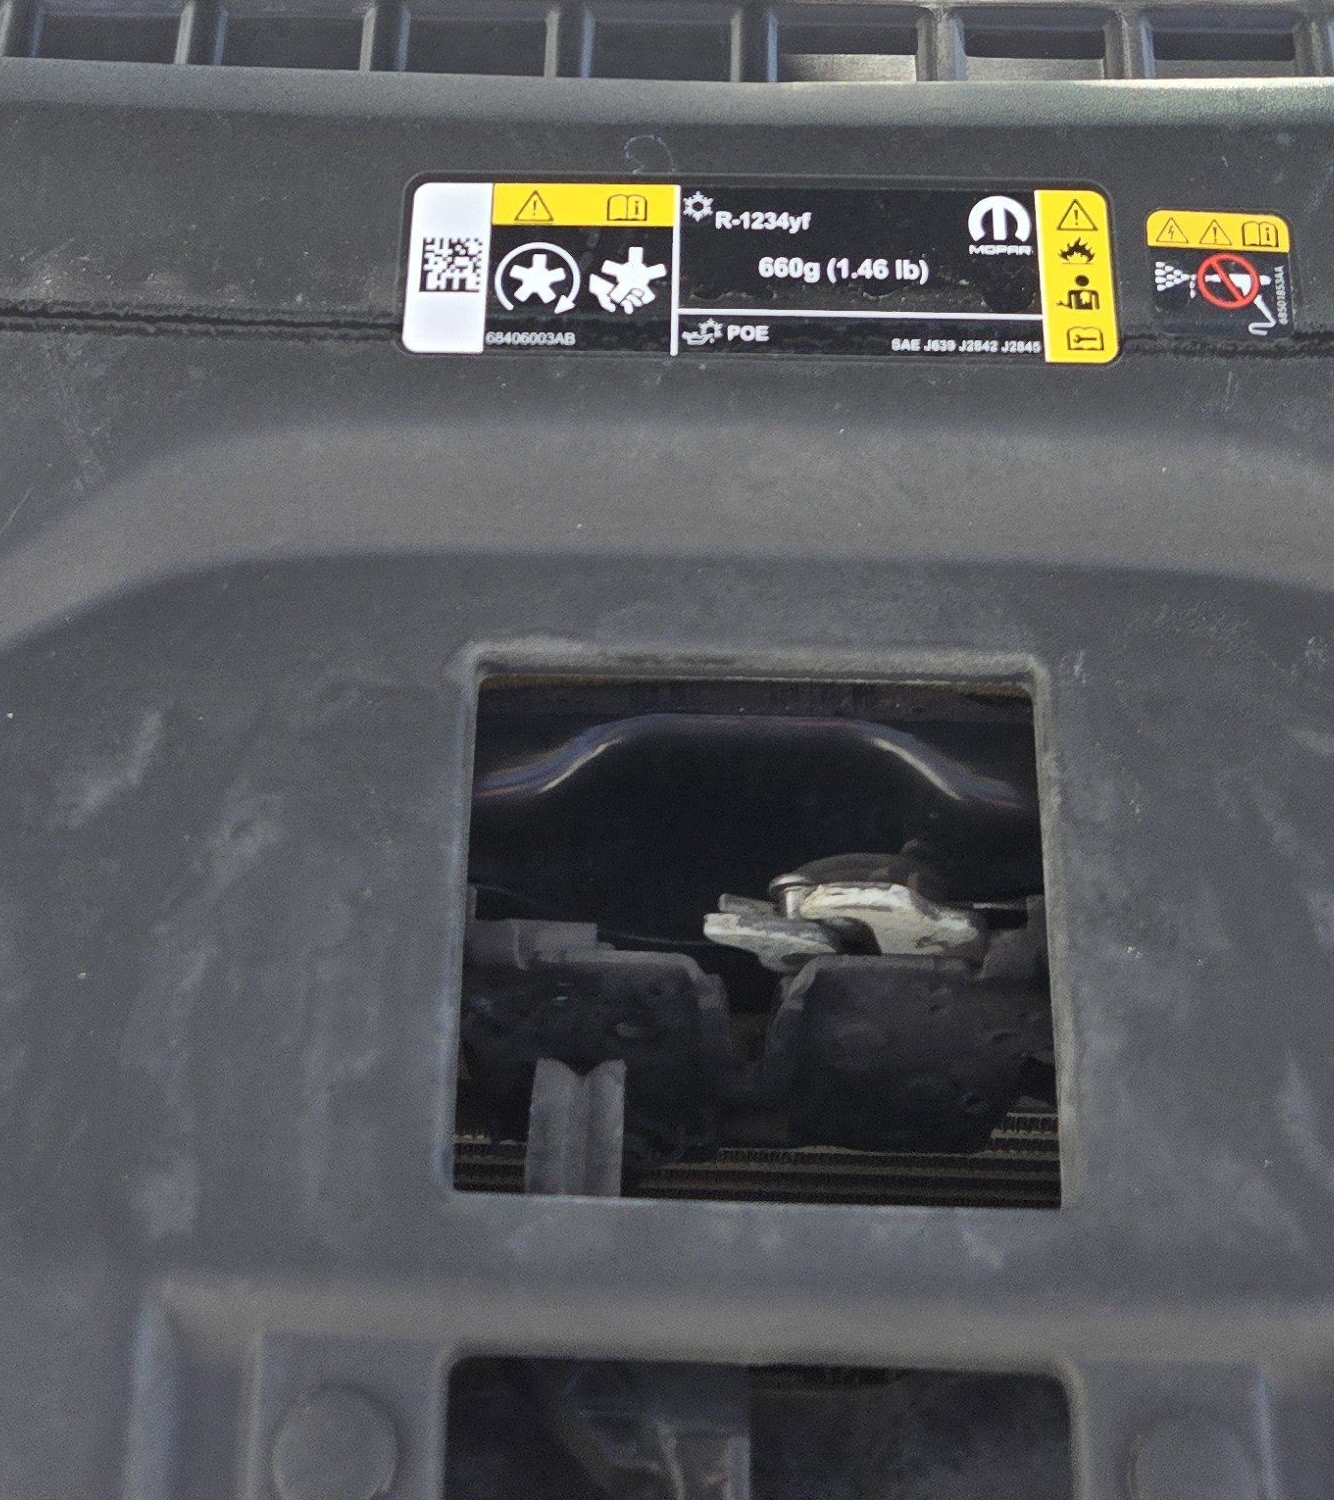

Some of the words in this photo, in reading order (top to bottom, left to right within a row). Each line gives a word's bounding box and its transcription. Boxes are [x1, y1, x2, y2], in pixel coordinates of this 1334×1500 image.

[715, 211, 812, 235] R-1234yf
[968, 244, 1032, 257] MOPAR
[758, 257, 821, 284] 660g
[826, 257, 889, 284] (1.46
[895, 259, 929, 286] lb)
[485, 331, 576, 347] 68406003AB
[727, 324, 770, 342] POE
[891, 338, 920, 351] SAE
[923, 338, 957, 353] J639
